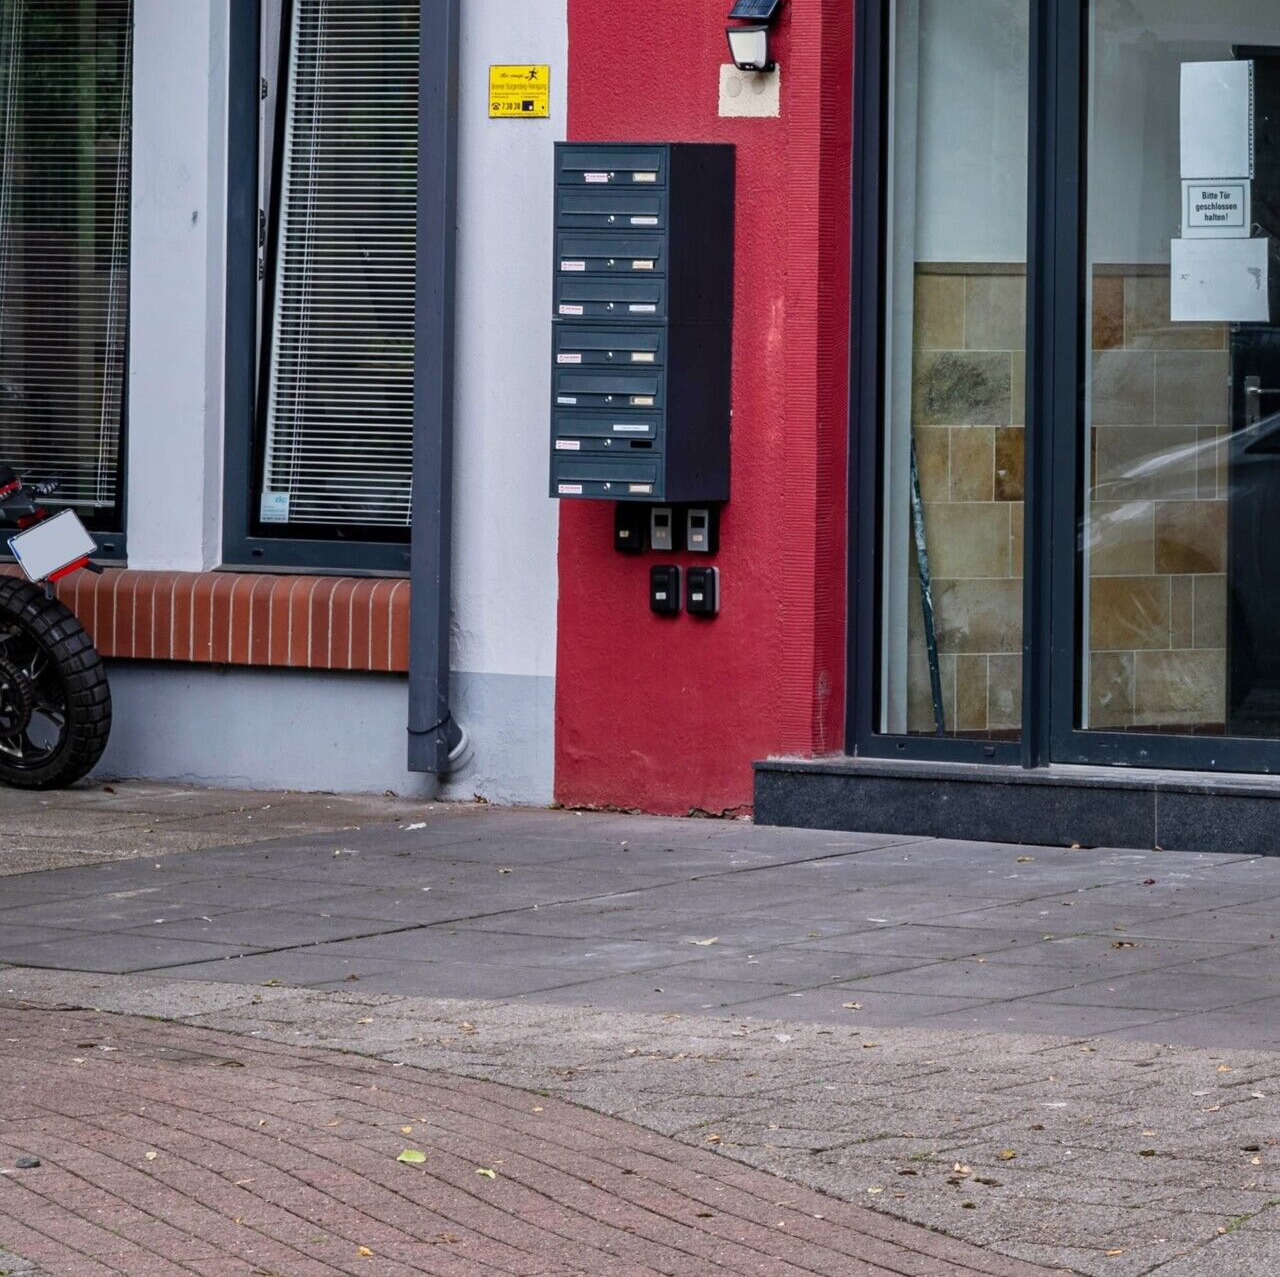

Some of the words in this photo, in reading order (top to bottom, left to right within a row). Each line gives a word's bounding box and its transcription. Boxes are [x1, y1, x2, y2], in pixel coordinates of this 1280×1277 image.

[1201, 191, 1218, 200] Bitte
[1219, 191, 1231, 200] Tür
[1195, 202, 1238, 212] geschlossen
[1204, 213, 1229, 221] halten!
